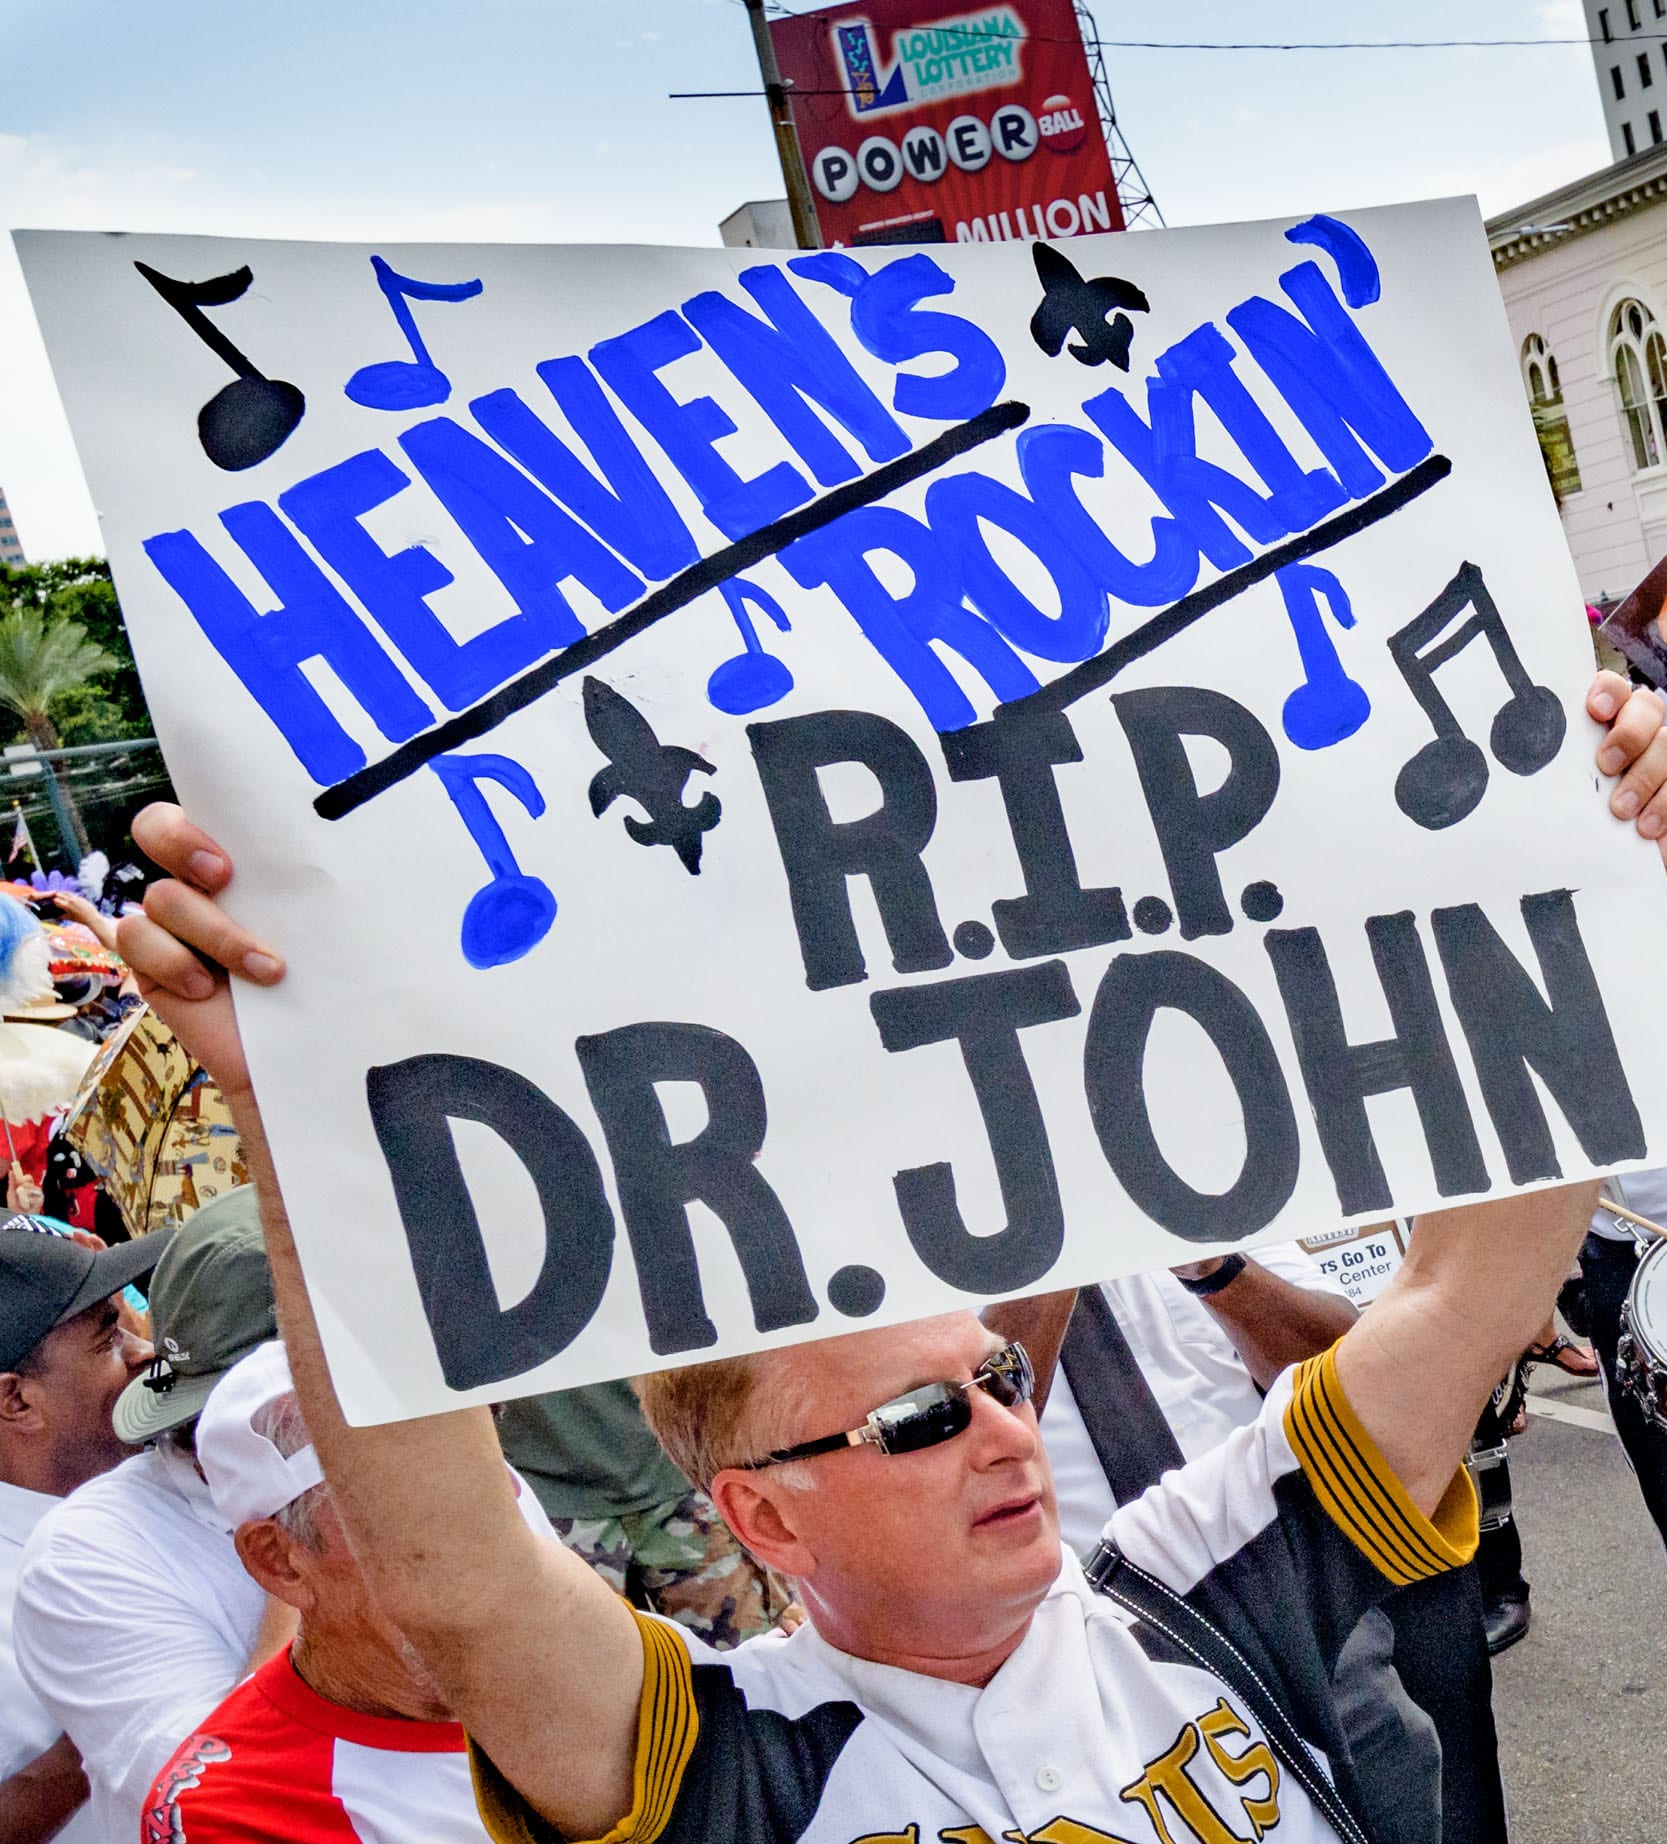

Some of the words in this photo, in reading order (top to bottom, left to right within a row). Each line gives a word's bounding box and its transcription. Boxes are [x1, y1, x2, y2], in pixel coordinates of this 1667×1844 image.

[898, 13, 1020, 64] LOUISIANA
[913, 41, 1013, 87] LOTTERY
[920, 67, 1017, 98] CORPORATION
[820, 111, 1034, 193] POWER
[1038, 107, 1085, 138] BALL
[955, 190, 1112, 244] MILLION
[776, 213, 1434, 733] ROCKIN'
[143, 251, 1006, 787] HEAVEN'S
[745, 686, 1285, 991] R.I.P.
[367, 1021, 887, 1391] DR.
[870, 887, 1648, 1295] JOHN
[1339, 1261, 1392, 1285] Center
[1341, 1251, 1365, 1267] Go
[1365, 1243, 1387, 1259] To
